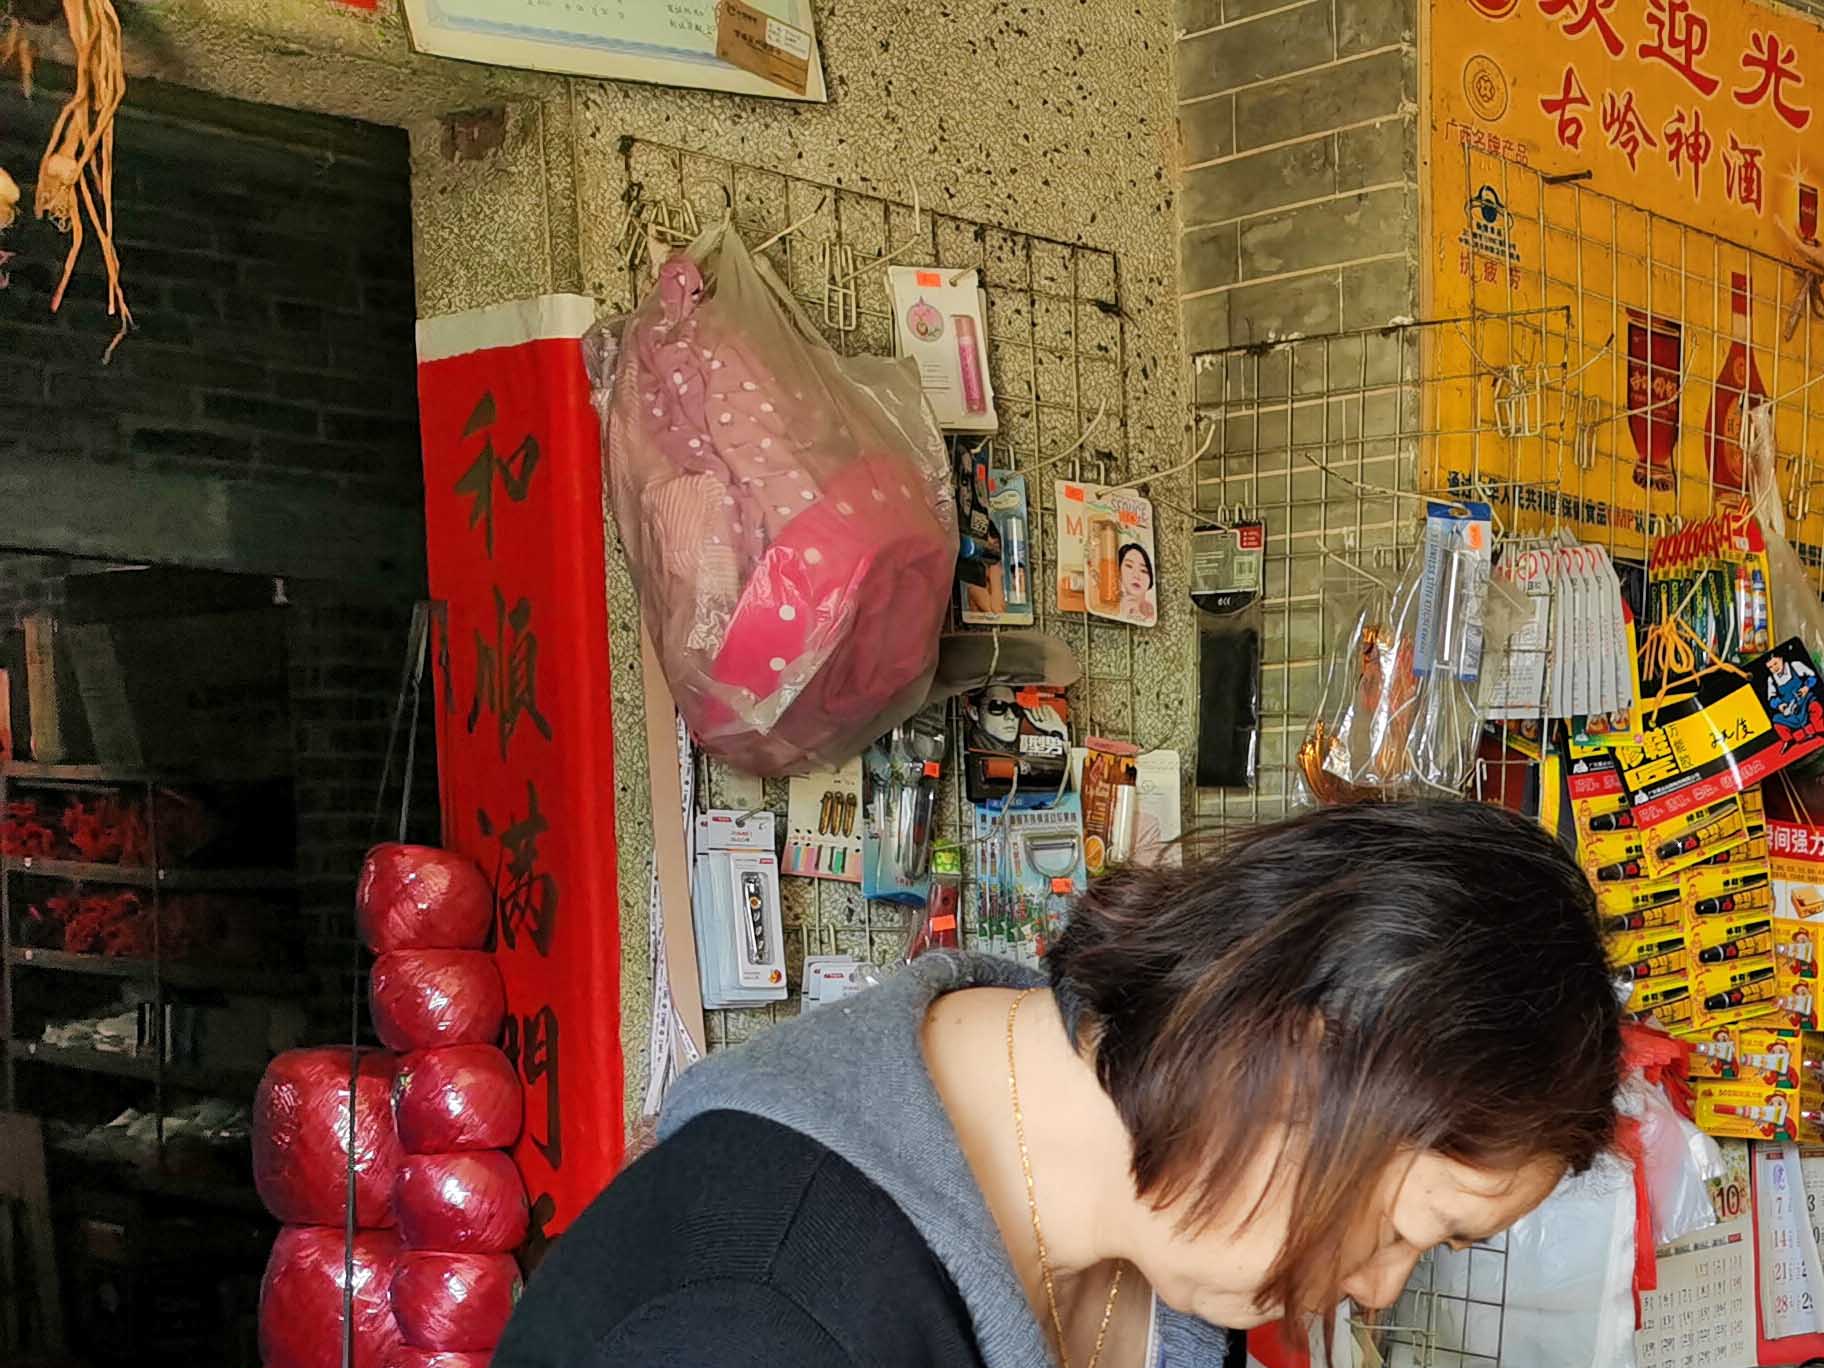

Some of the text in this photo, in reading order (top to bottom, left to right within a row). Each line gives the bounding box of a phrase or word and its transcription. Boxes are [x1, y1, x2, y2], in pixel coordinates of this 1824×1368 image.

[1540, 65, 1764, 214] 古岭神酒
[1715, 1184, 1740, 1217] 10
[1807, 1194, 1816, 1212] 3
[1774, 1263, 1787, 1280] 21
[1775, 1296, 1788, 1313] 28
